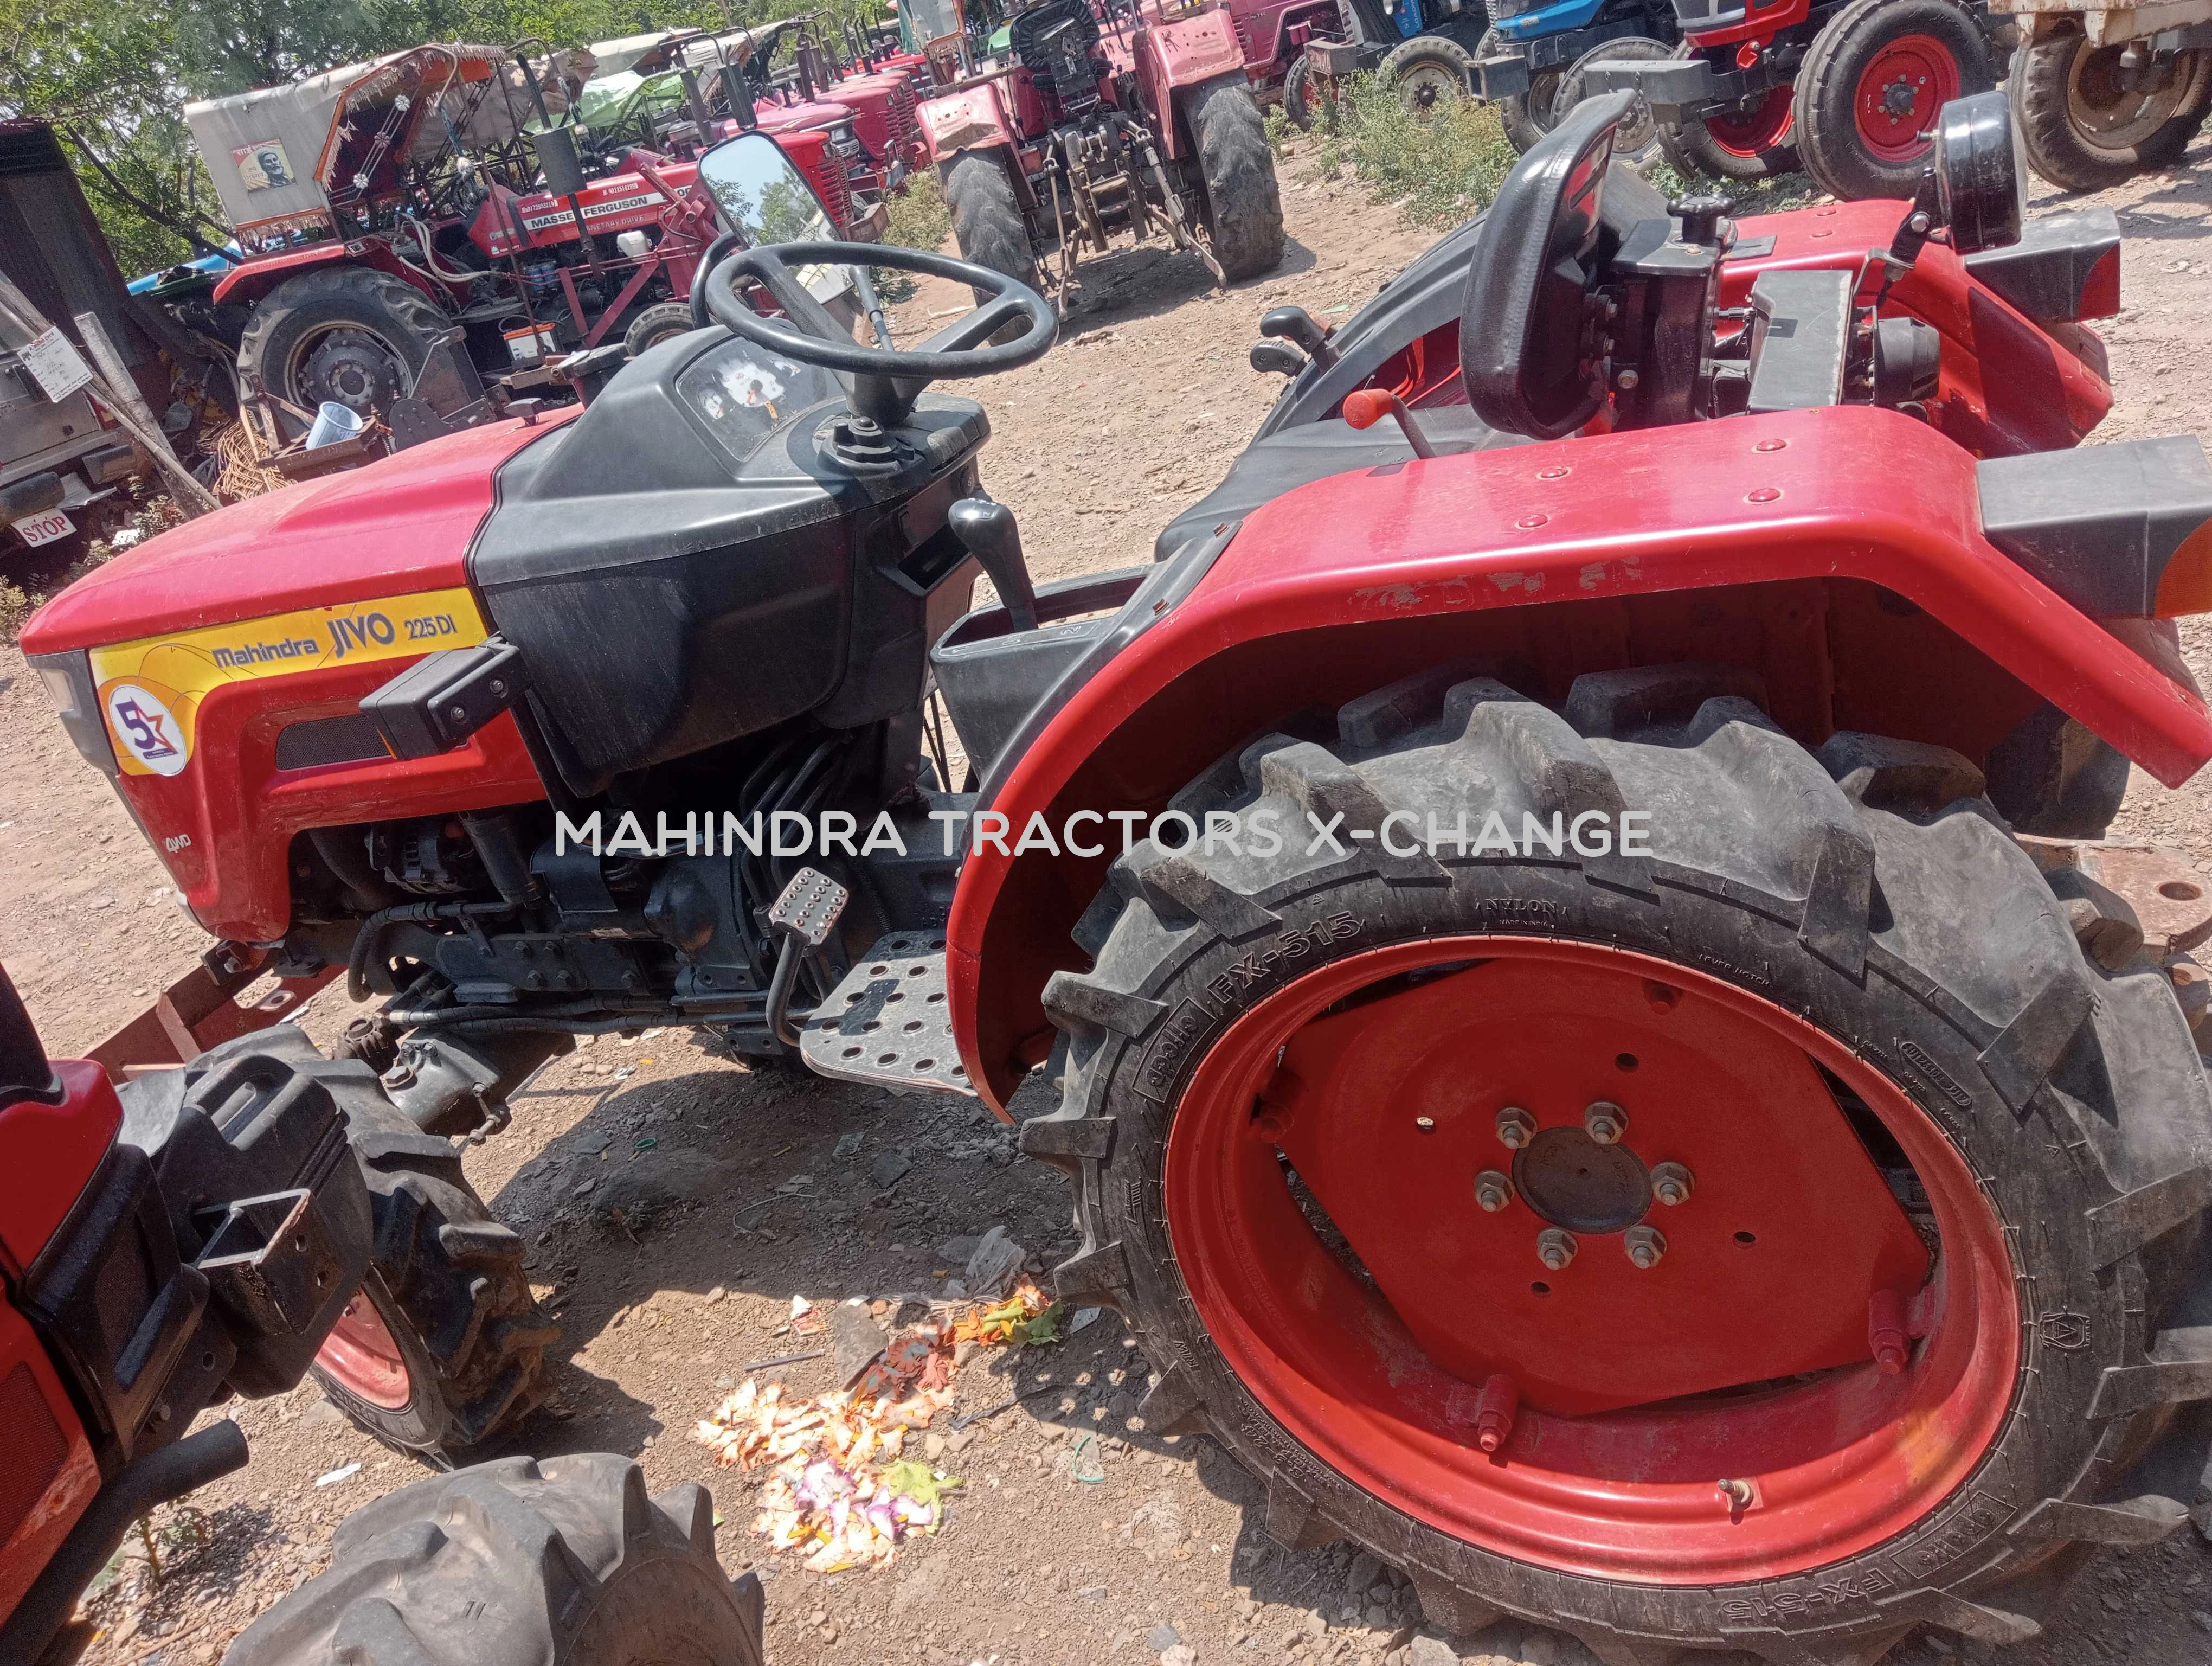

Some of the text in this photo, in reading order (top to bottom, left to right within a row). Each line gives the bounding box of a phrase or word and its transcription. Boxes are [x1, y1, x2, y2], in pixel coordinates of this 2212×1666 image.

[531, 196, 648, 228] MASSE FERGUSON
[621, 215, 645, 225] DRIVE
[22, 516, 67, 542] STOP
[211, 637, 321, 669] Mahindra
[326, 611, 396, 659] JIVO
[166, 834, 191, 853] 4WD
[1484, 898, 1558, 913] NYLON
[1146, 910, 1361, 1087] apollo FX-515
[1721, 1568, 1895, 1620] FX-515
